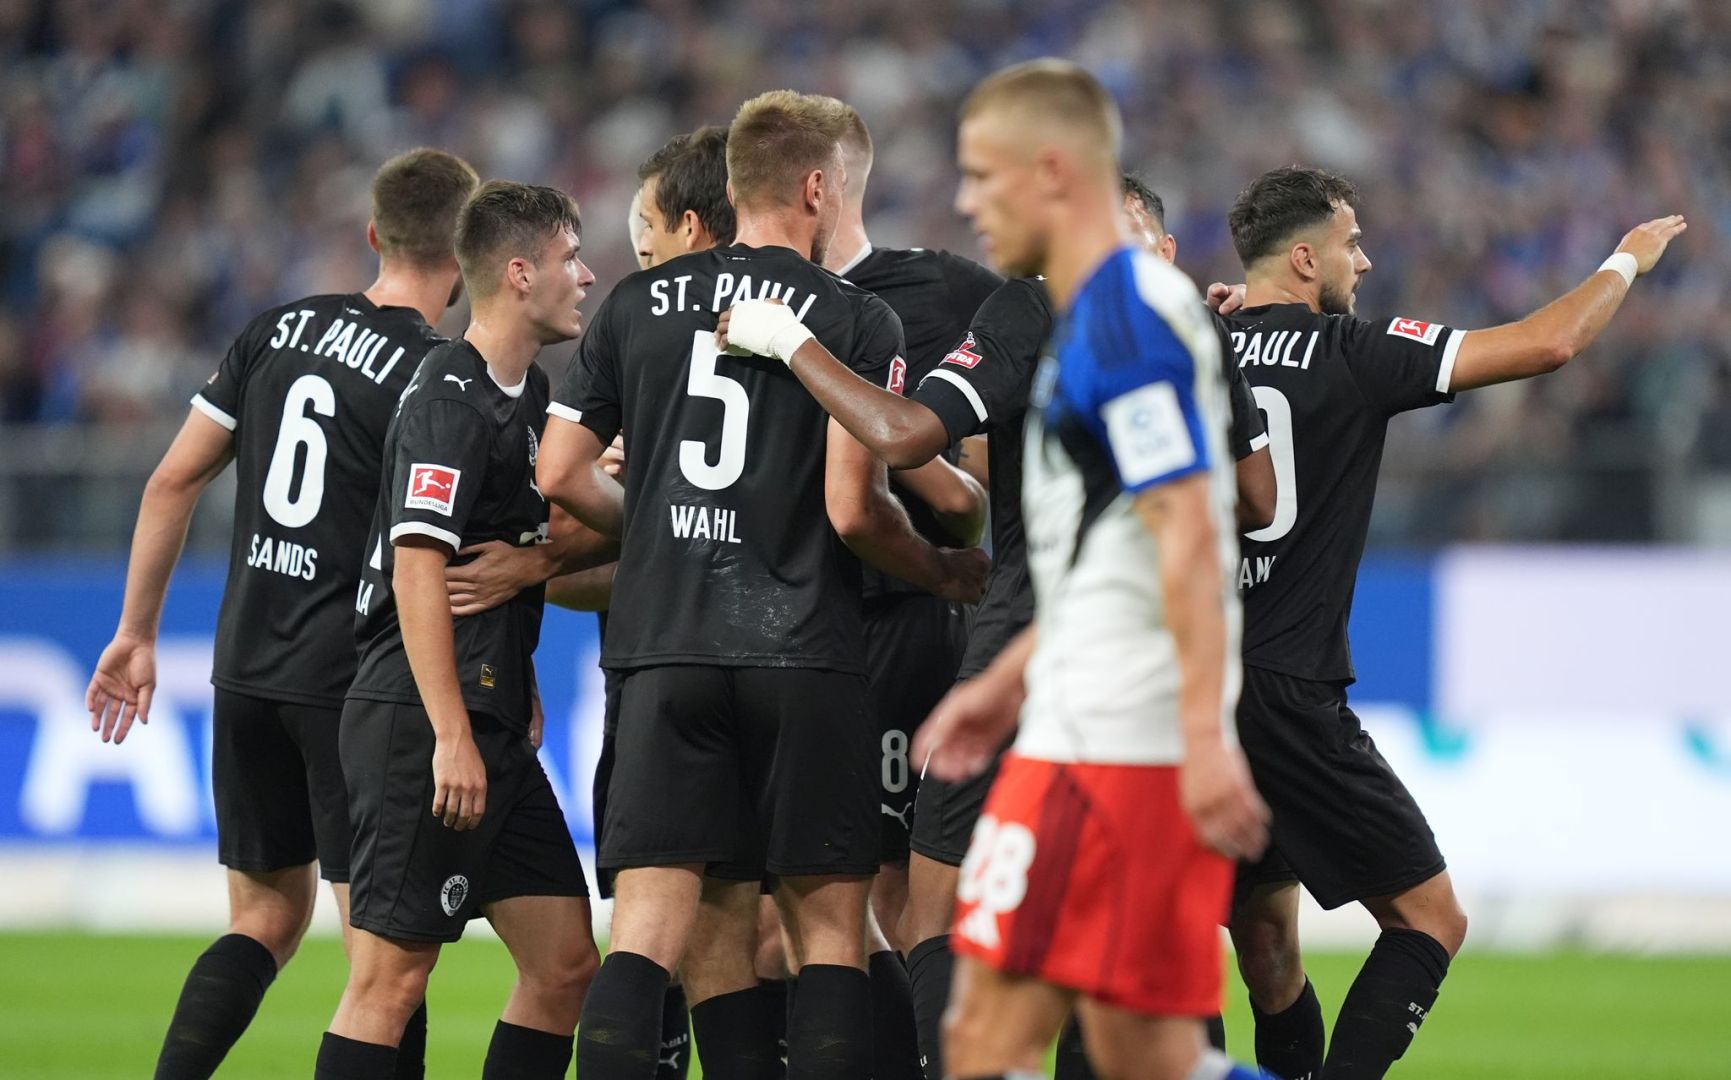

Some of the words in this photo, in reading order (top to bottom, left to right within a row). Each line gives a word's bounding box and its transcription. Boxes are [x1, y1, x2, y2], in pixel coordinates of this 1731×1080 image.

[650, 275, 700, 316] ST.
[270, 310, 315, 353] ST.
[314, 318, 405, 384] PAULI
[1231, 330, 1320, 370] PAULI
[679, 330, 749, 490] 5
[263, 374, 336, 528] 6
[671, 505, 742, 543] WAHL
[248, 534, 318, 581] SANDS
[881, 729, 908, 793] 8
